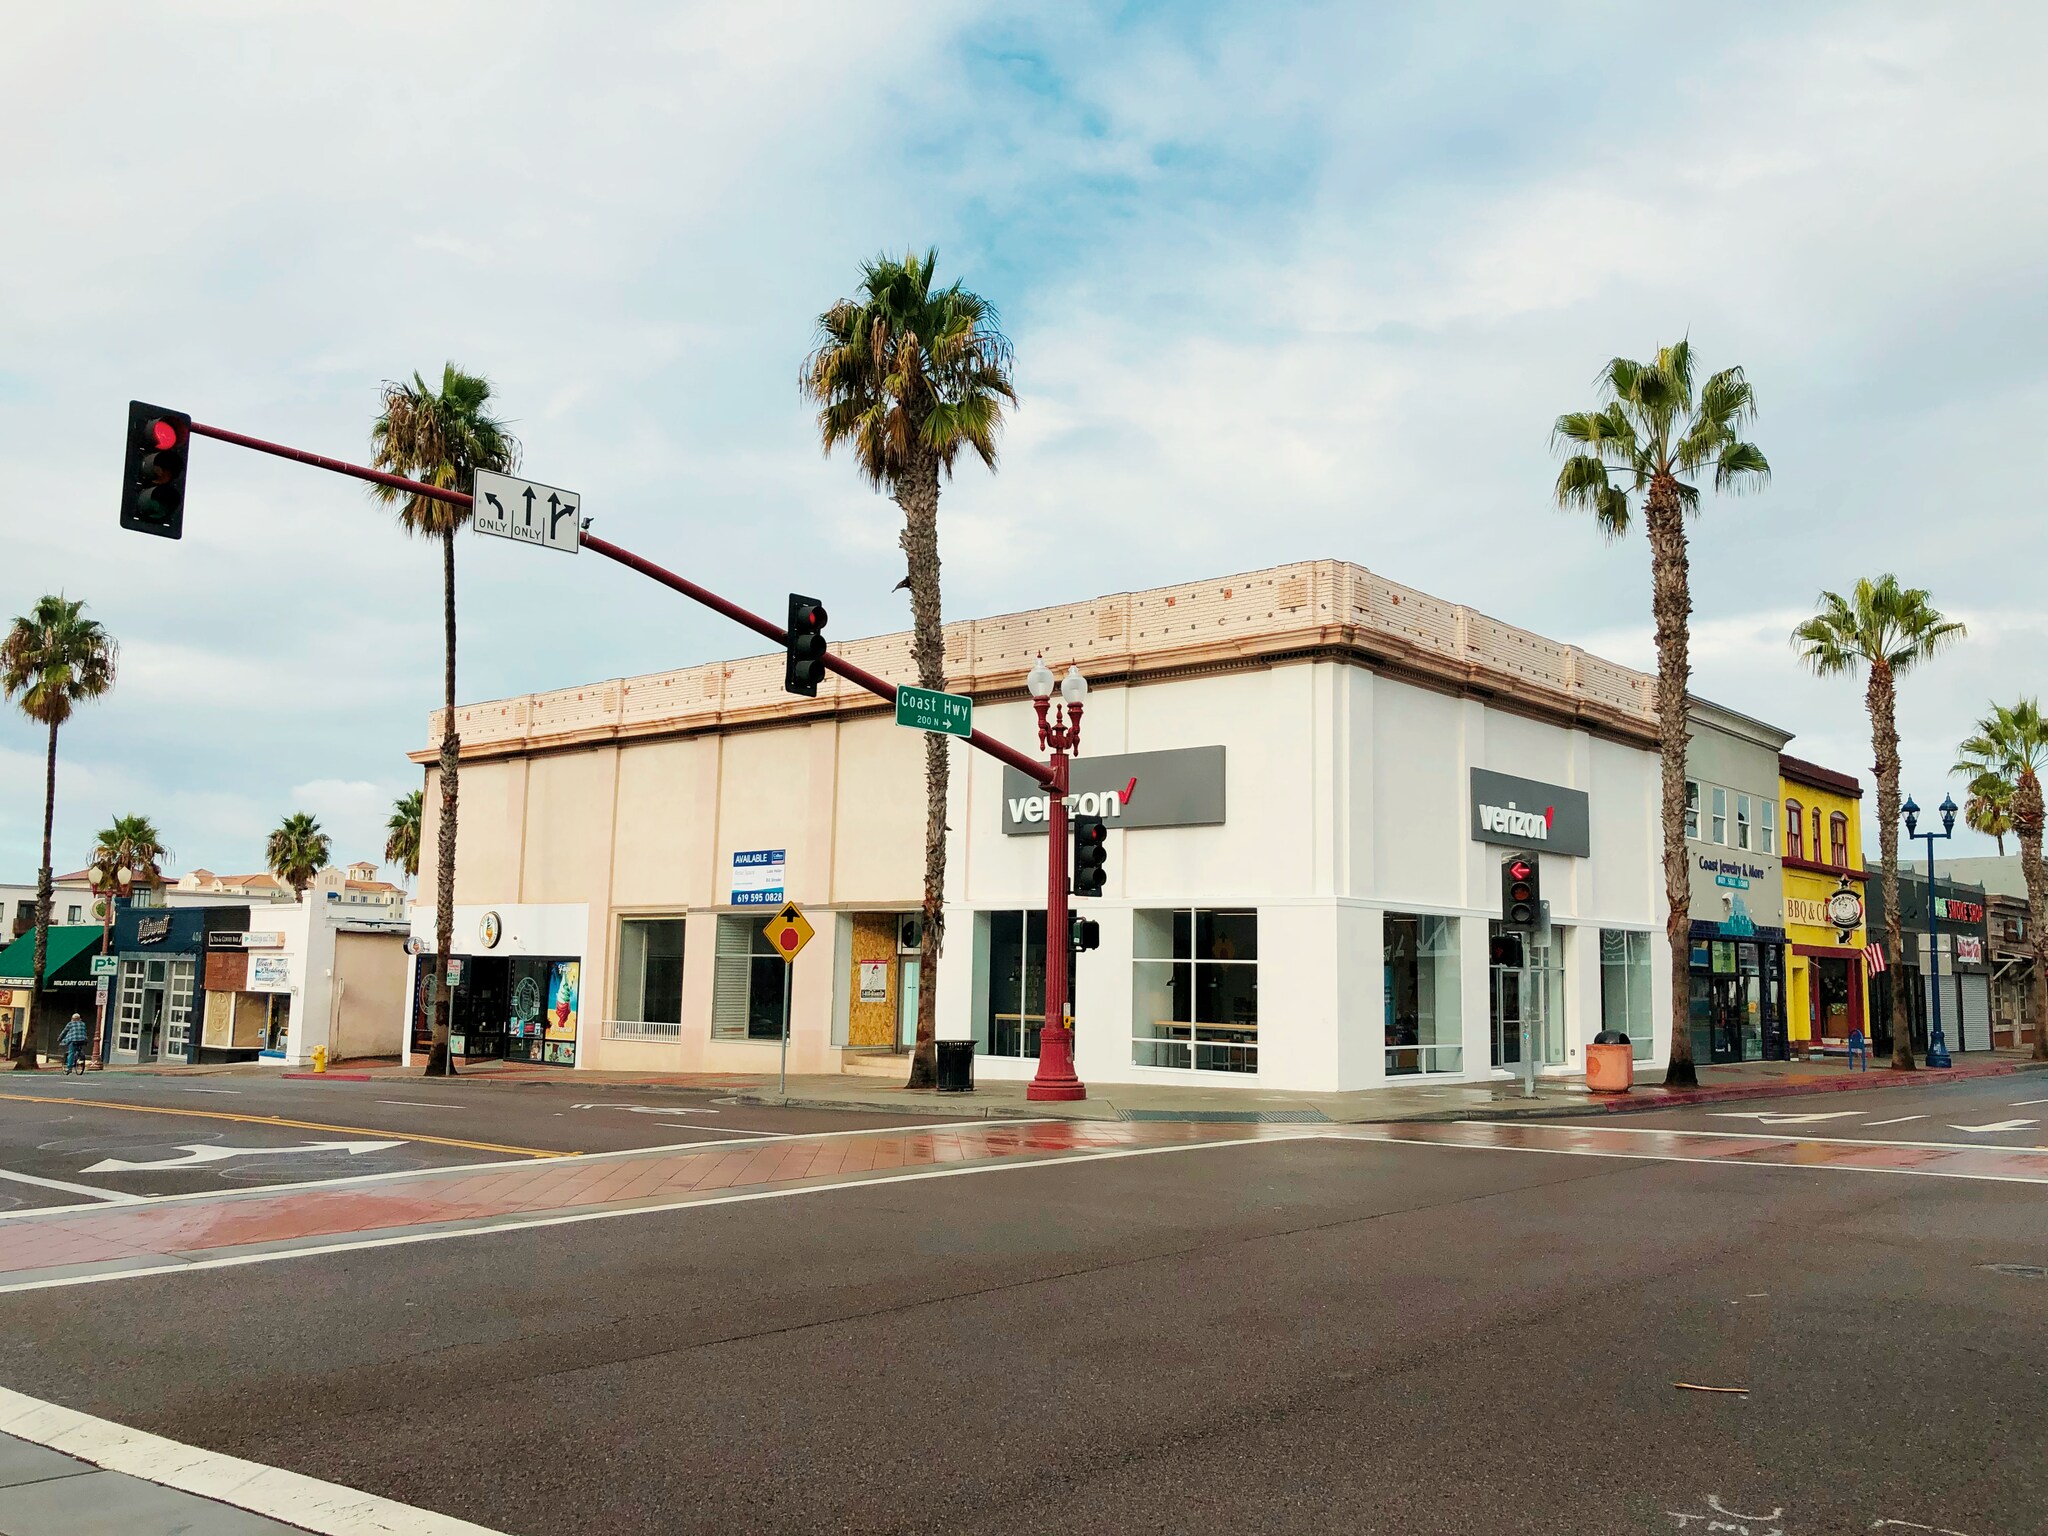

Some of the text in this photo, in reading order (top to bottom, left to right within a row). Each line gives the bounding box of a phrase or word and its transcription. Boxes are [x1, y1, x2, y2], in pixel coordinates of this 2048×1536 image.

[479, 518, 507, 532] ONLY
[514, 526, 541, 540] ONLY
[901, 691, 968, 721] Coast Hwy
[917, 715, 939, 726] 200 N
[1479, 801, 1547, 840] verizon
[735, 853, 768, 864] AVAILABLE
[1699, 855, 1718, 872] Coast
[1742, 863, 1748, 877] &
[1749, 864, 1764, 879] More
[737, 892, 783, 903] 619 595 0828
[1787, 899, 1806, 923] BBQ
[1808, 903, 1815, 920] &
[1948, 899, 1968, 921] SMOKE
[1969, 902, 1983, 922] SHOP
